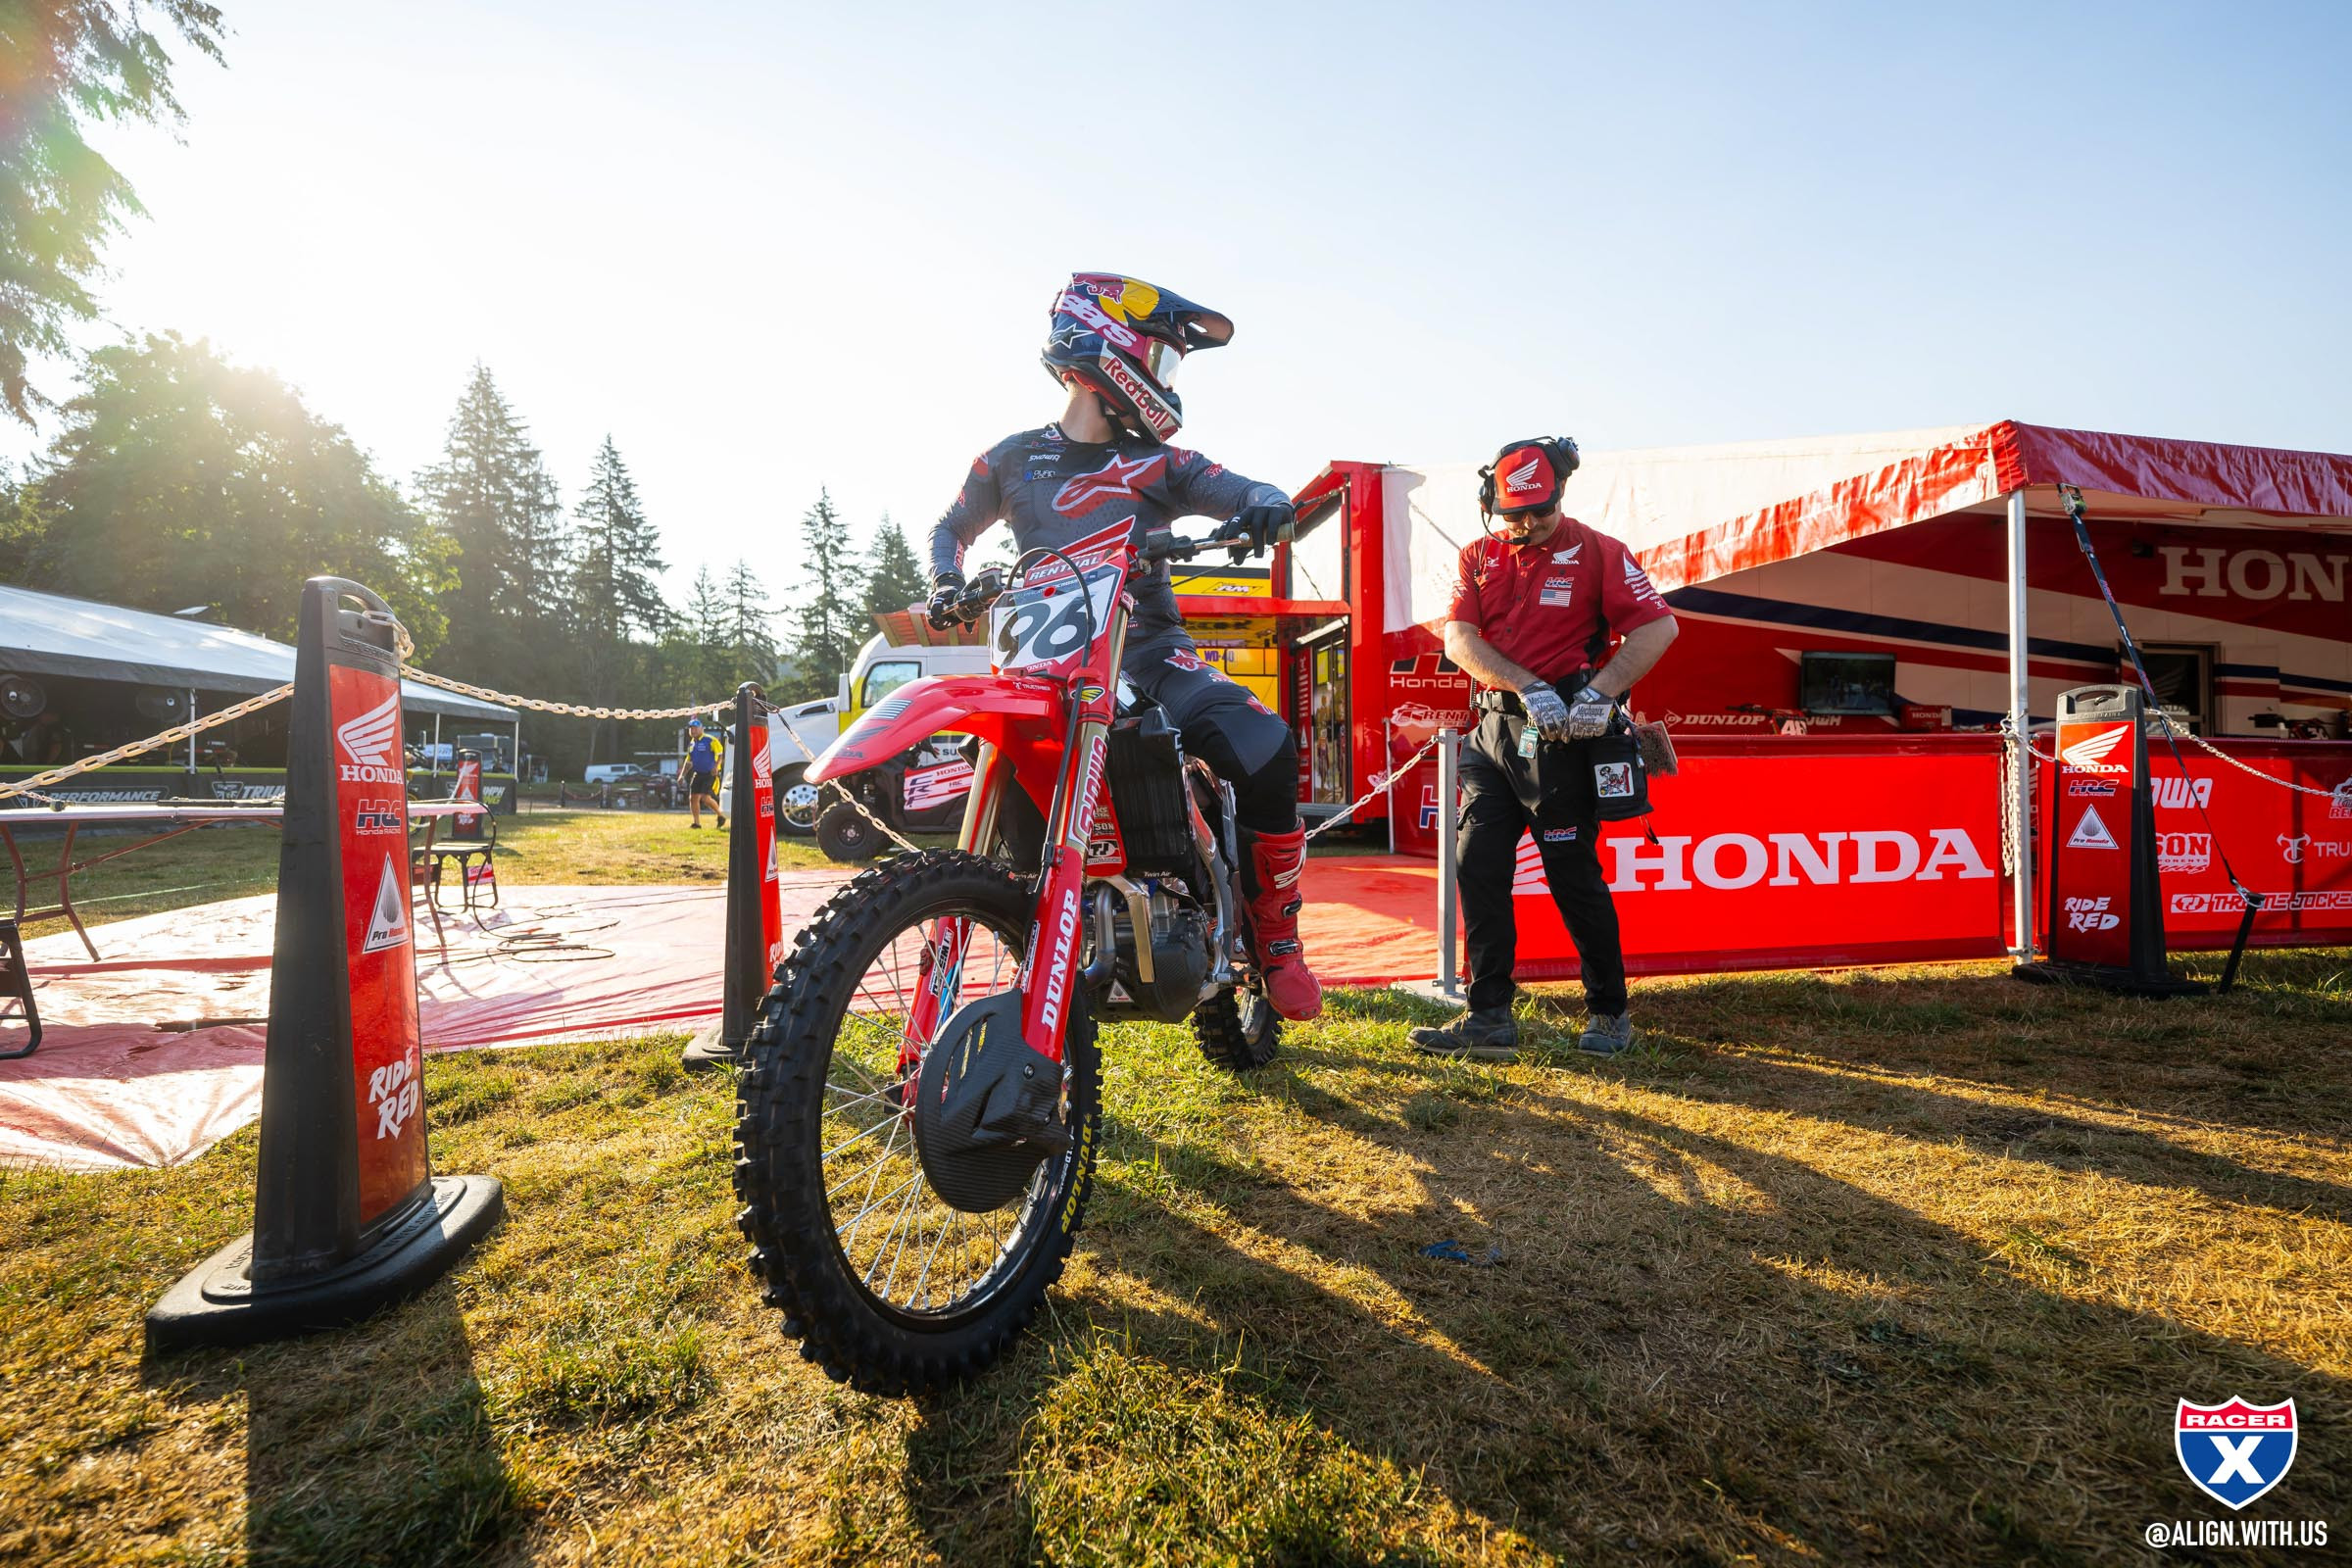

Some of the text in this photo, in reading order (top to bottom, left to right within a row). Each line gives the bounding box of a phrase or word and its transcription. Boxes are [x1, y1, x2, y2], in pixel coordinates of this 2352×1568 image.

[1059, 294, 1138, 347] stars
[1506, 482, 1543, 493] HONDA
[2158, 545, 2352, 603] HON
[998, 594, 1097, 668] 96
[1390, 676, 1468, 689] Honda
[1683, 713, 1765, 725] DUNLOP
[340, 764, 404, 784] HONDA
[936, 765, 971, 777] HONDA
[2062, 764, 2130, 774] HONDA
[50, 790, 161, 803] PERFORMANCE
[2068, 779, 2120, 795] HRC
[356, 799, 402, 829] HRC
[2314, 842, 2351, 858] TRU
[1605, 828, 1995, 893] HONDA
[2064, 896, 2111, 912] RIDE
[2068, 911, 2120, 934] RED
[371, 930, 388, 942] Pro
[1042, 889, 1077, 1033] DUNLOP
[368, 1045, 414, 1103] RIDE
[376, 1079, 419, 1141] RED
[1061, 1123, 1093, 1234] DUNLOP
